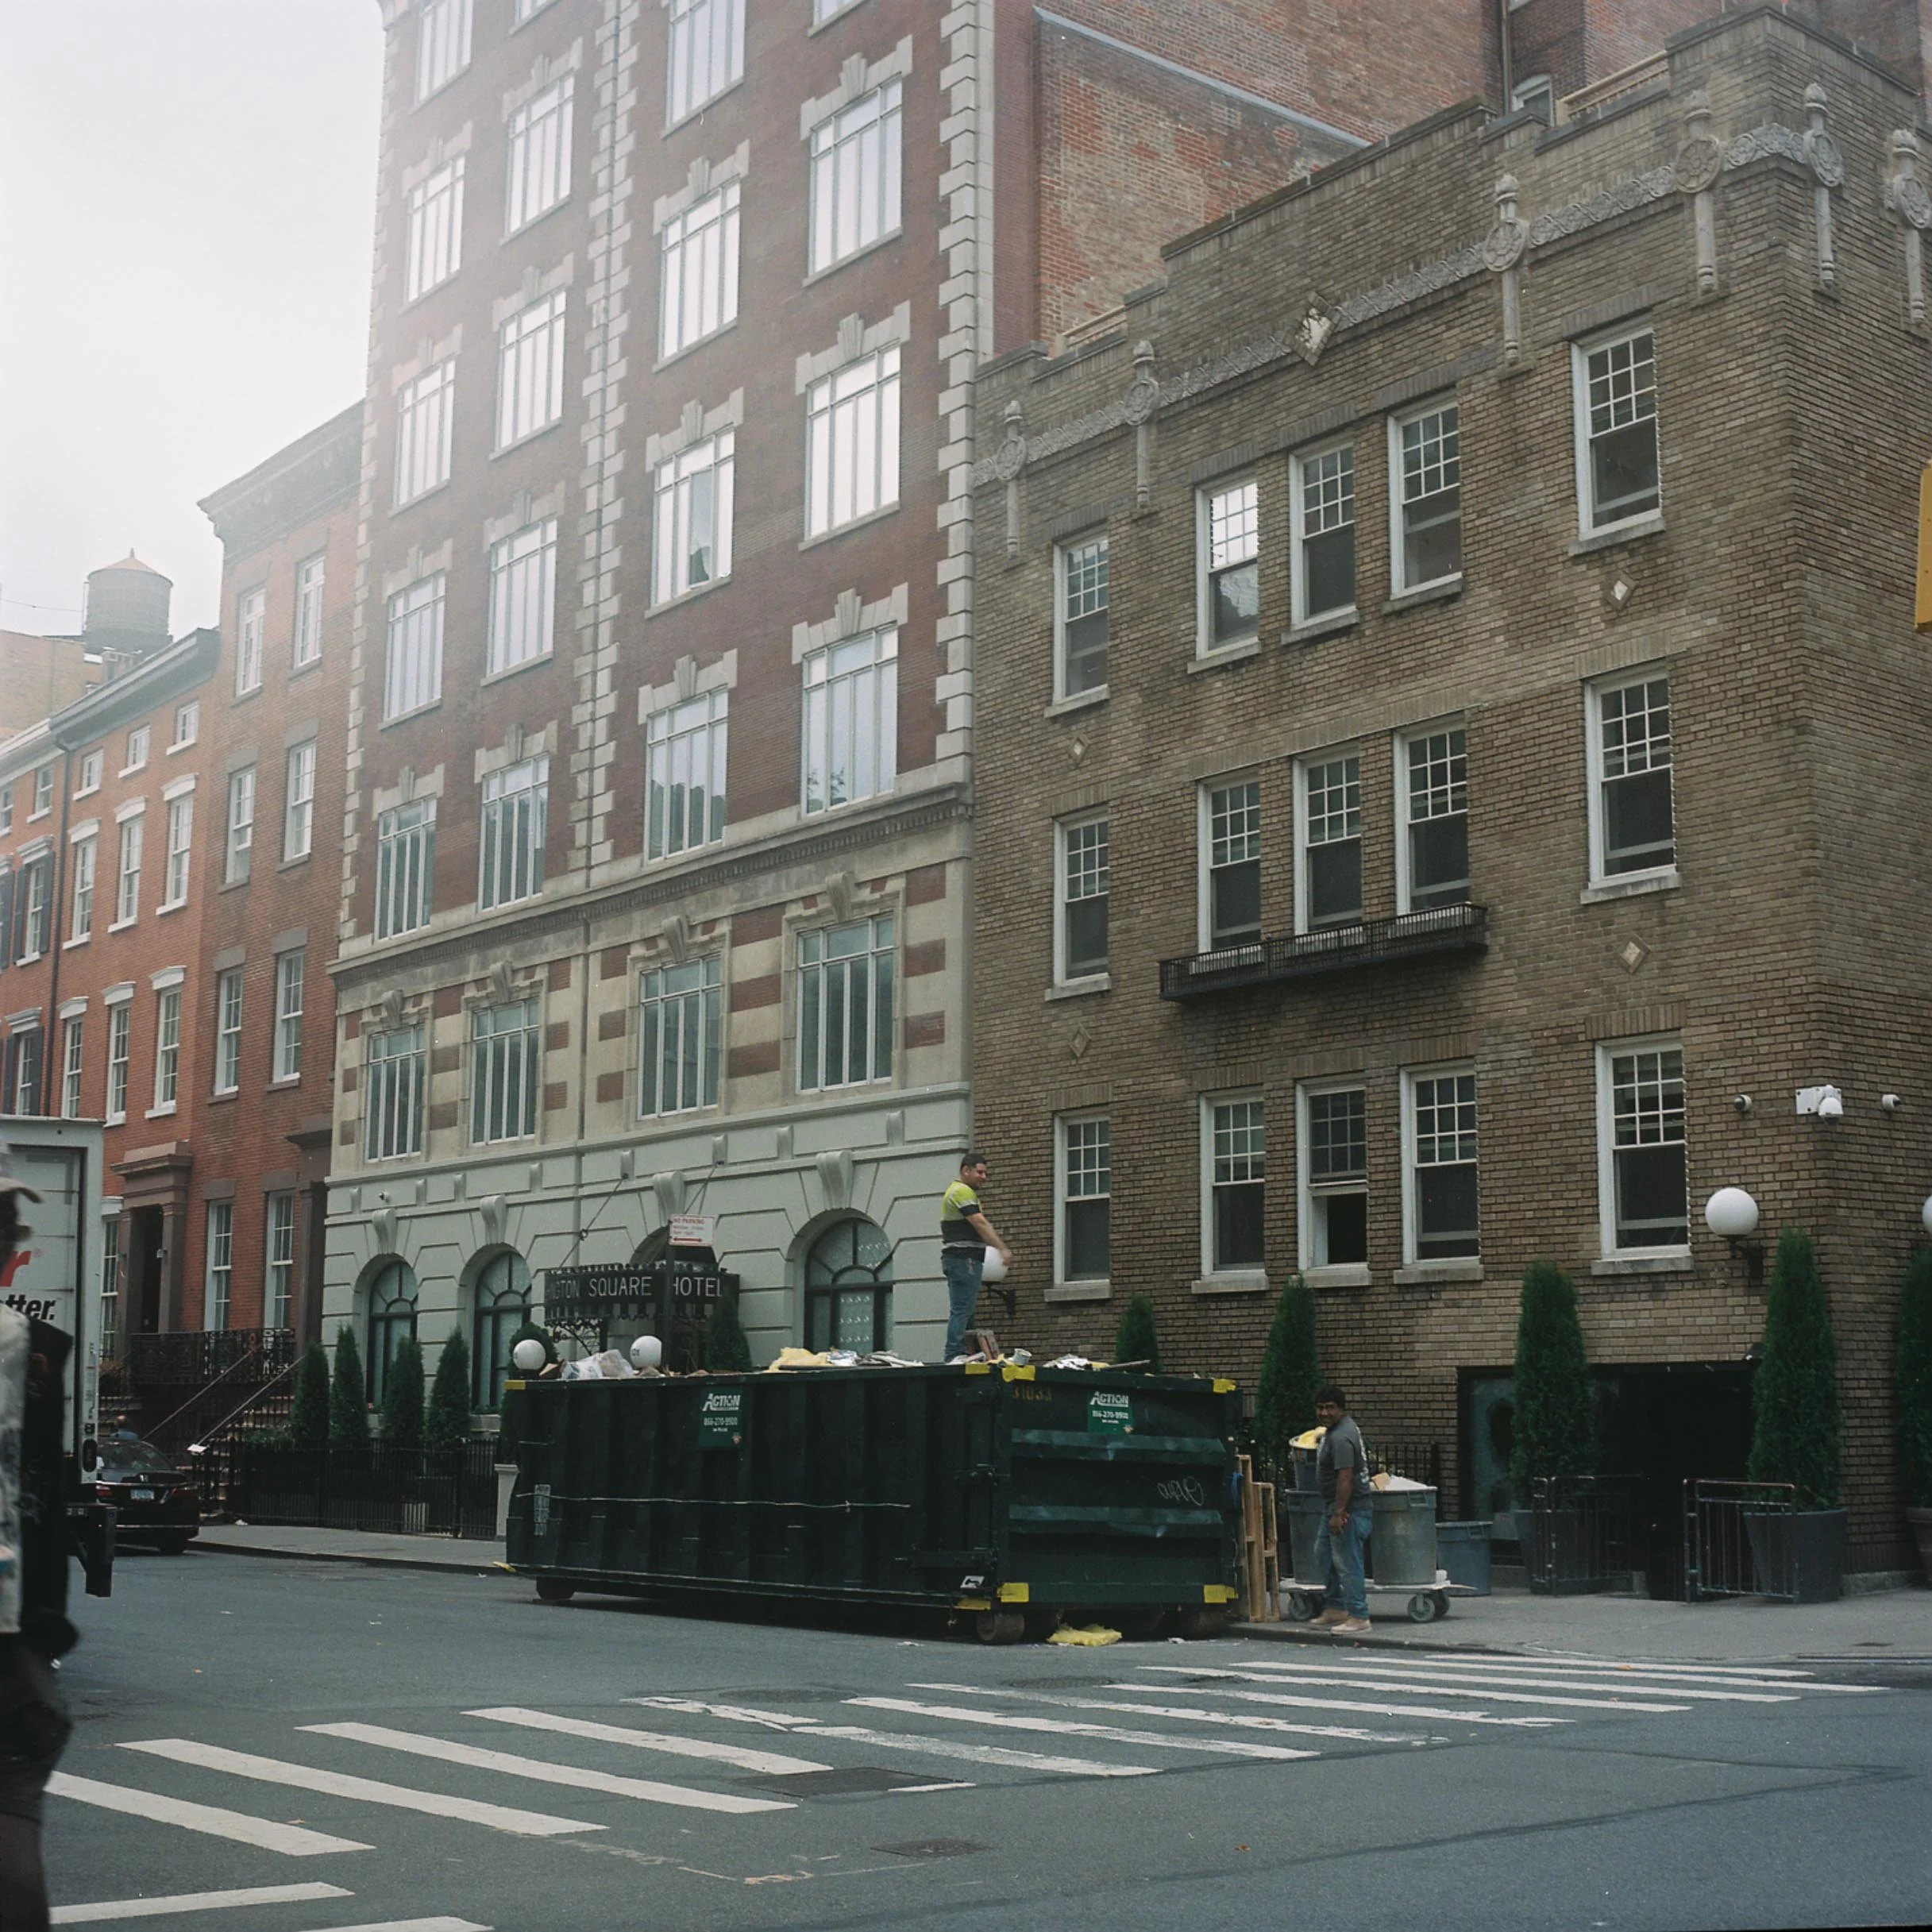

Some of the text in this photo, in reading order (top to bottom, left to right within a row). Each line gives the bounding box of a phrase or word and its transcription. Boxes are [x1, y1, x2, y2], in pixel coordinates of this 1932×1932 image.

[588, 1276, 653, 1298] SQUARE
[702, 1393, 741, 1411] ACTION
[1089, 1390, 1129, 1407] ACTION
